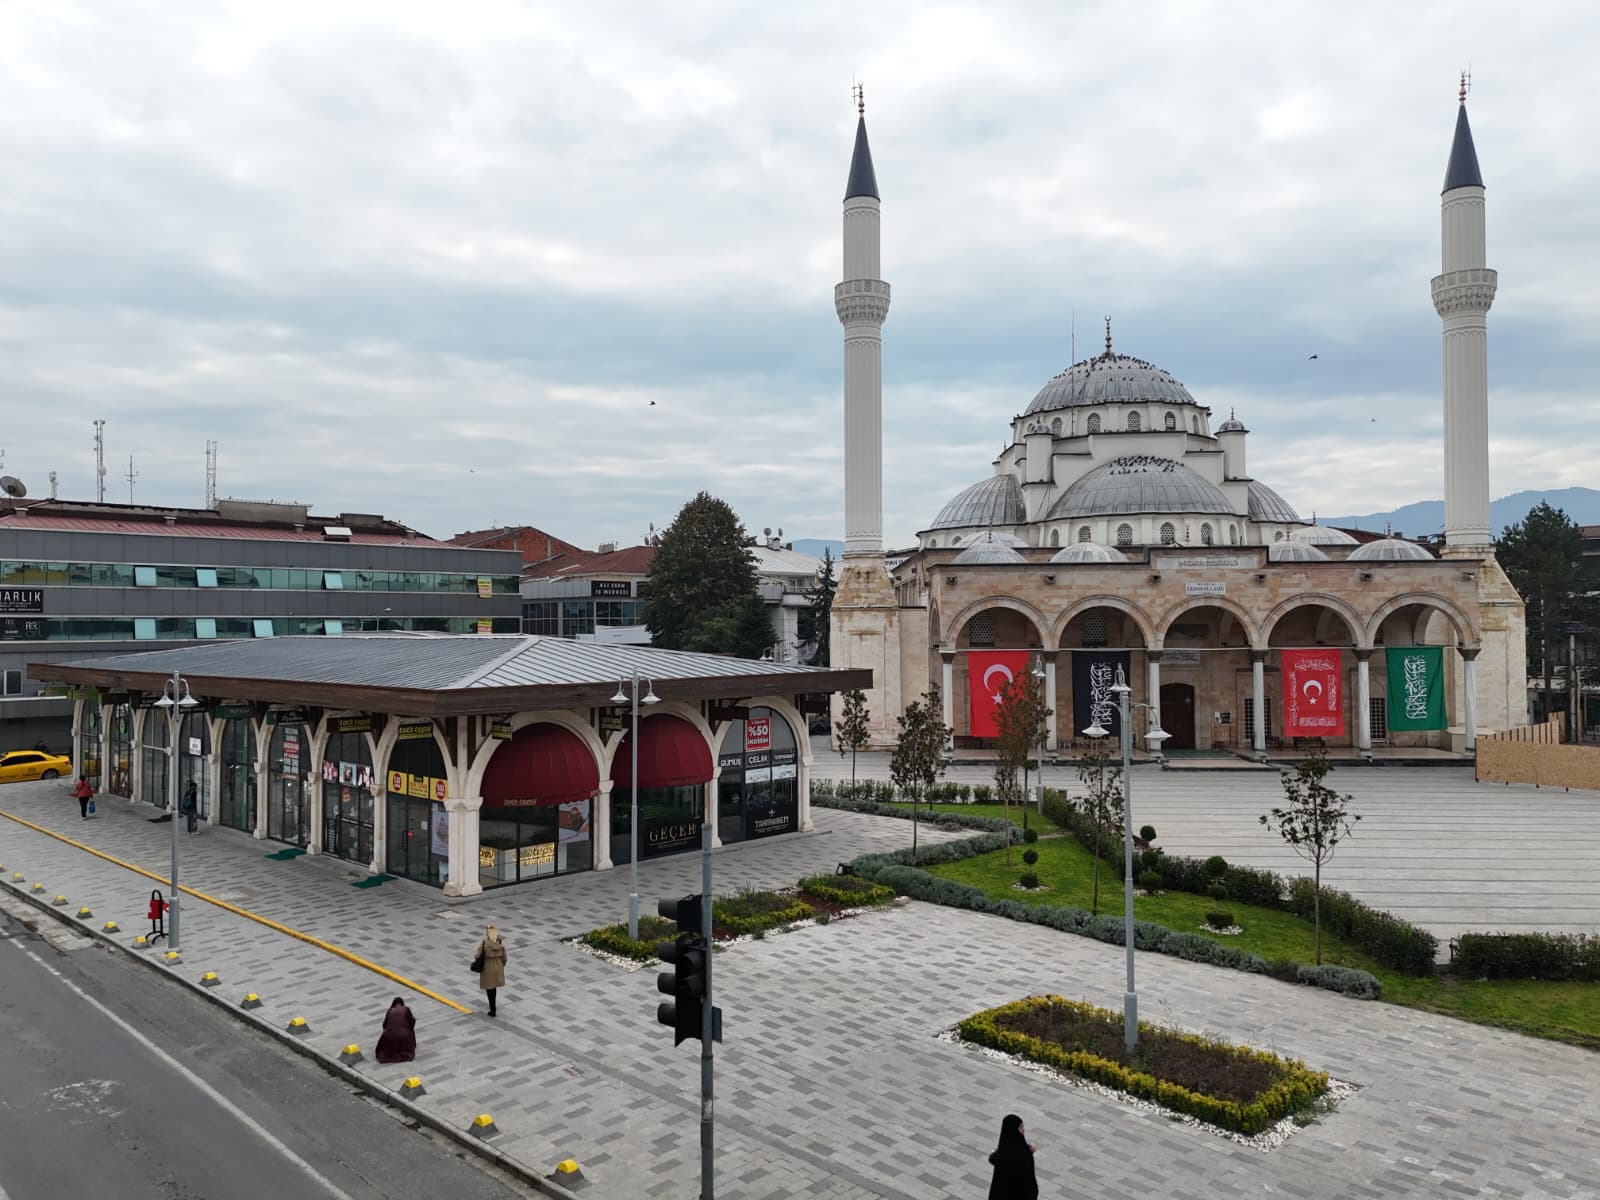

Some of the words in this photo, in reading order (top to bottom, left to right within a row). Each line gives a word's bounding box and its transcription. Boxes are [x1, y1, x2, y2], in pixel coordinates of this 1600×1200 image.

[0, 591, 41, 602] ARLIK
[748, 725, 768, 737] %50
[649, 823, 696, 842] GEÇER
